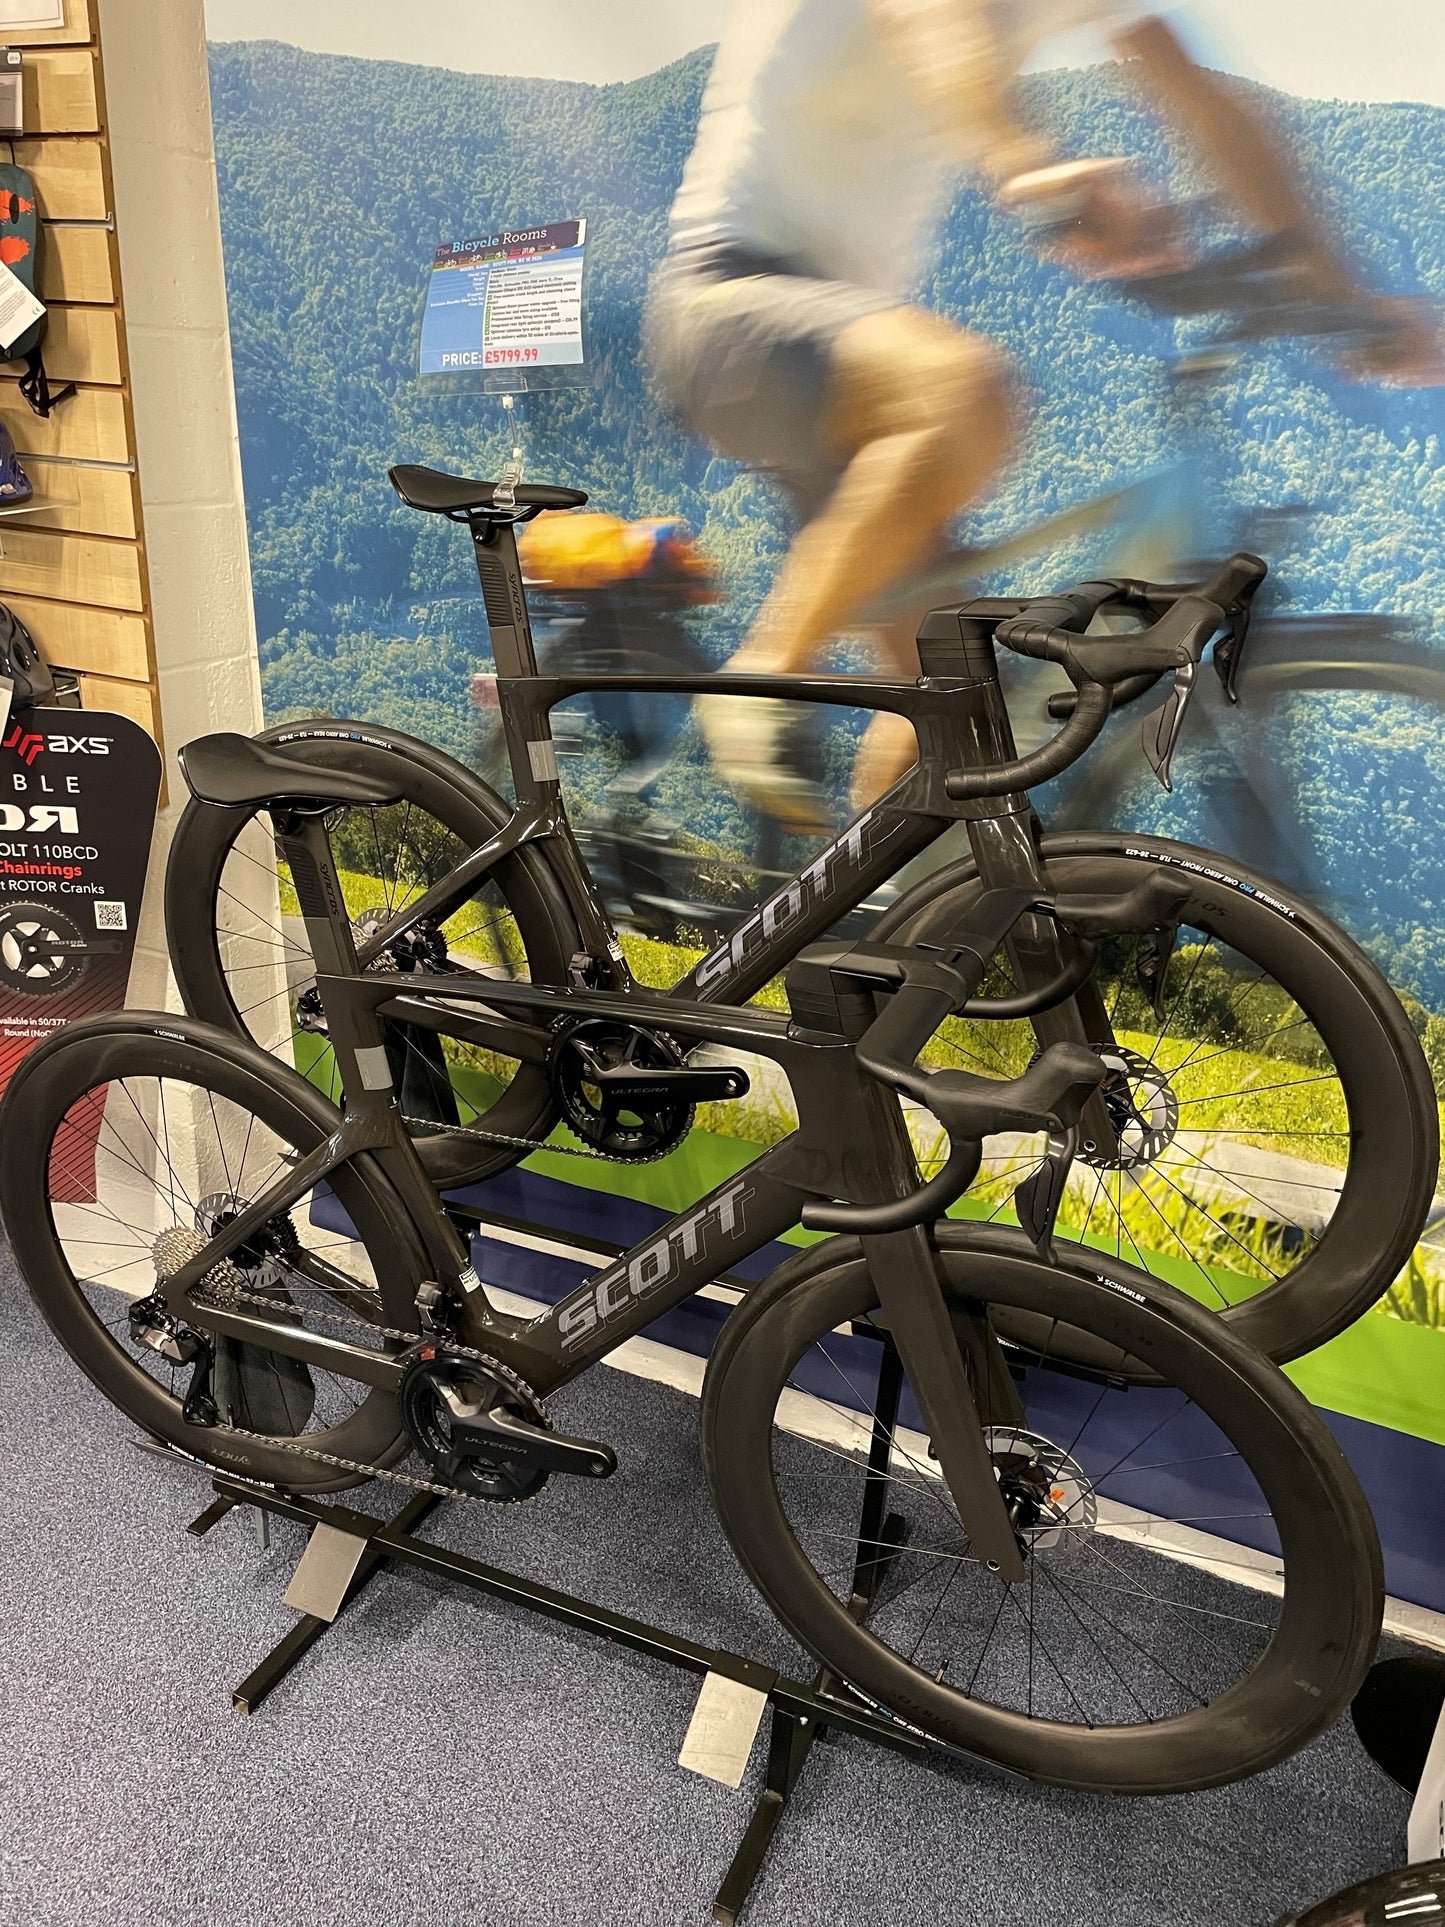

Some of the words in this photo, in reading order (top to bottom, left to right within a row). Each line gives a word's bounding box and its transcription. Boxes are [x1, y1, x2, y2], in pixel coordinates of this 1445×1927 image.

[437, 248, 450, 256] The
[452, 235, 500, 253] Bicycle
[502, 229, 548, 245] Rooms
[442, 352, 482, 367] PRICE:
[485, 348, 539, 364] £5799.99
[33, 844, 99, 860] 110BCD
[1180, 859, 1205, 873] FRONT
[1203, 867, 1225, 881] AERO
[8, 879, 58, 893] ROTOR
[60, 881, 106, 895] Cranks
[1221, 874, 1239, 887] ONE
[1238, 881, 1256, 894] PRO
[695, 811, 877, 1002] SCOTT
[1254, 890, 1290, 915] SCHWALBE
[29, 1017, 37, 1026] in
[38, 1018, 67, 1026] 50/37T
[4, 1028, 30, 1038] Round
[611, 1087, 669, 1095] ULTEGRA
[559, 1182, 750, 1350] SCOTT
[1103, 1279, 1147, 1303] SCHWALBE
[464, 1436, 528, 1455] ULTEGRA
